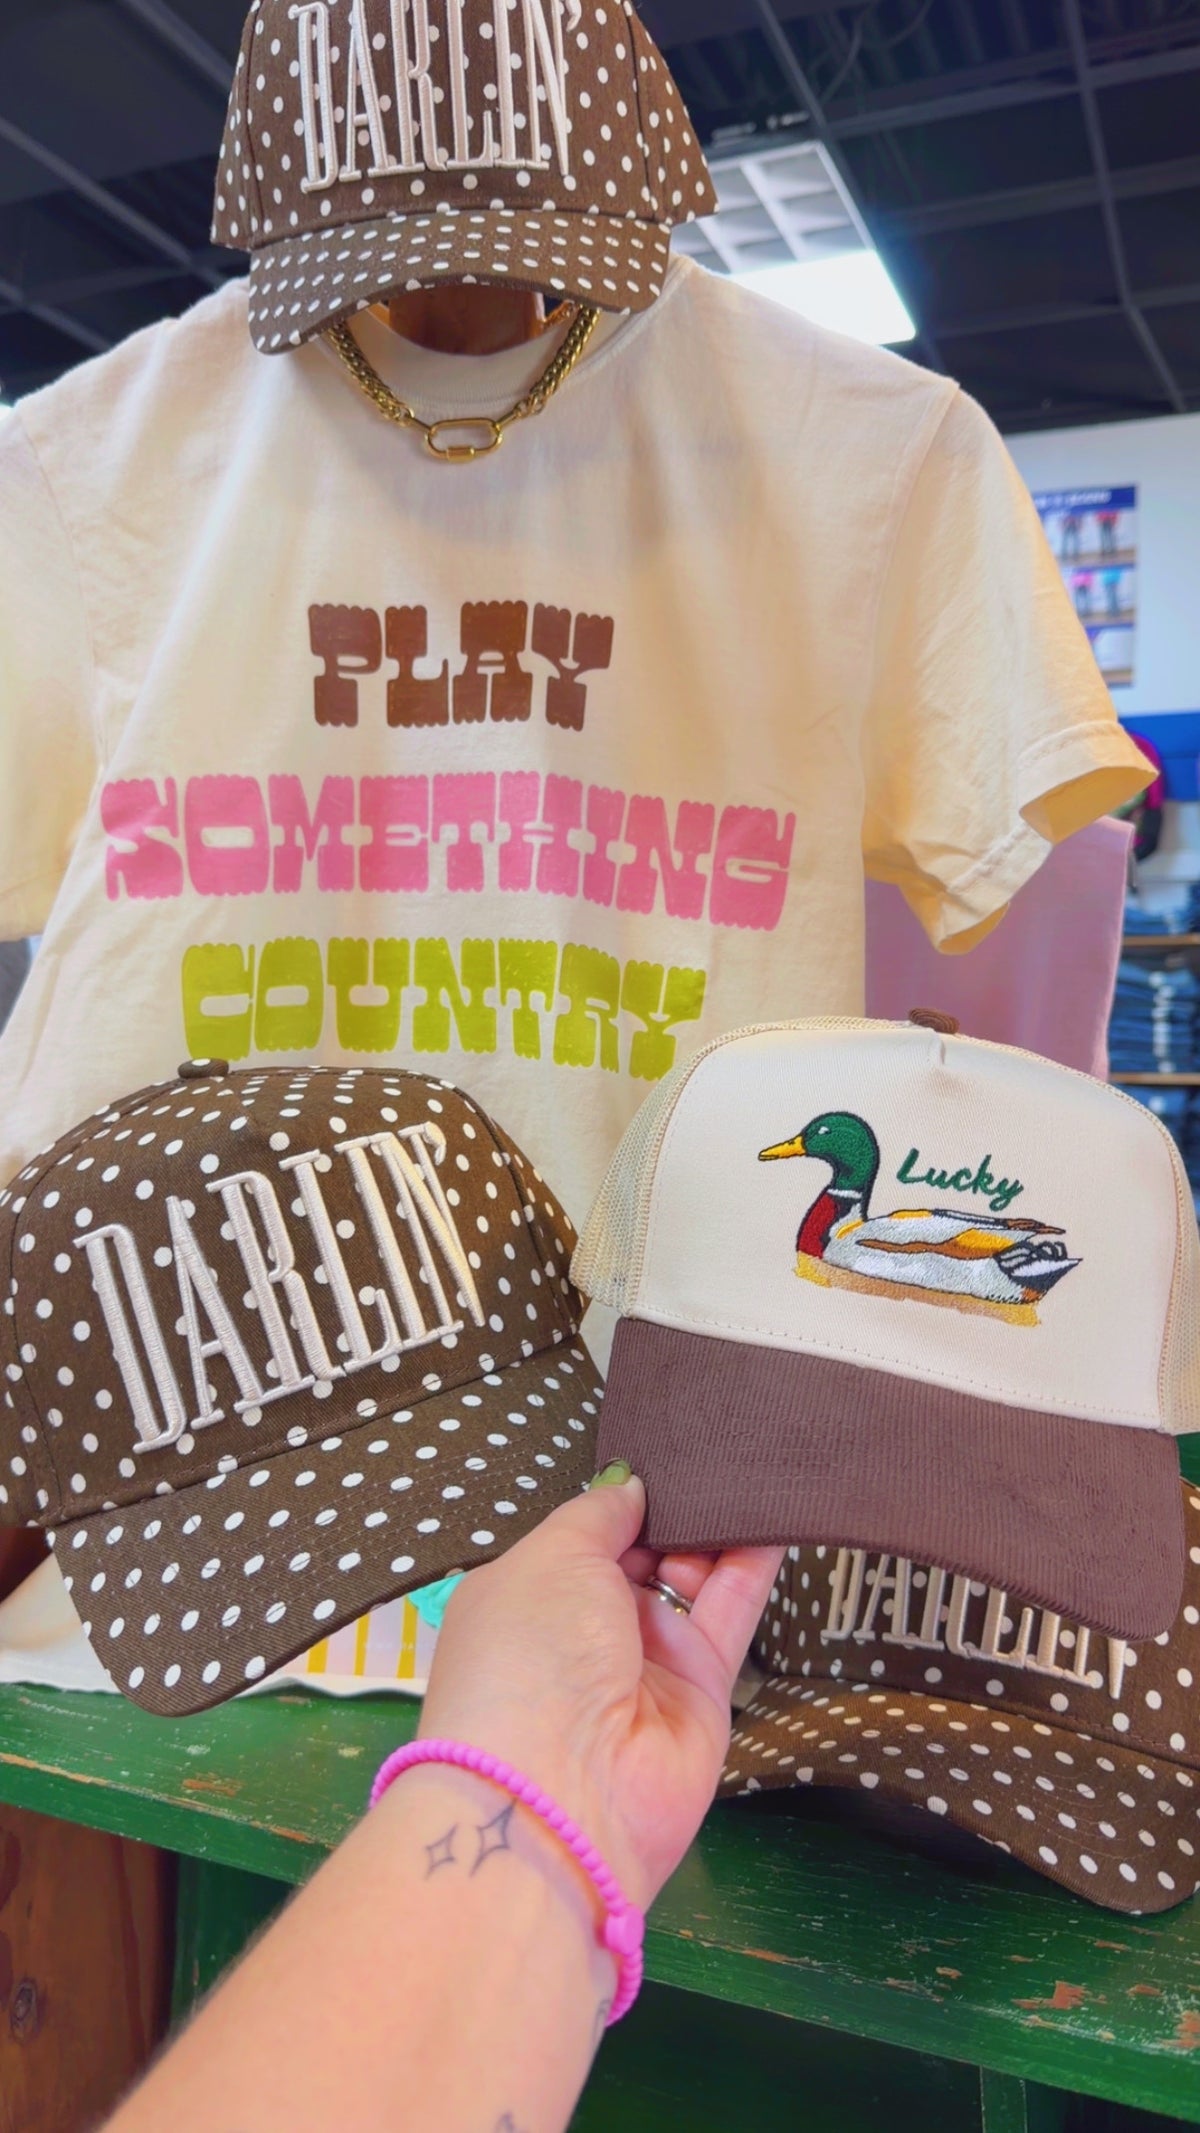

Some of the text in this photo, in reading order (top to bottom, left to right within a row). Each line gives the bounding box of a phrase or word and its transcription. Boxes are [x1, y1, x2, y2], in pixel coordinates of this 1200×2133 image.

[308, 601, 614, 731] PLAY
[101, 771, 796, 931] SOMETHING
[181, 936, 706, 1081] COUNTRY
[897, 1148, 1024, 1212] Lucky
